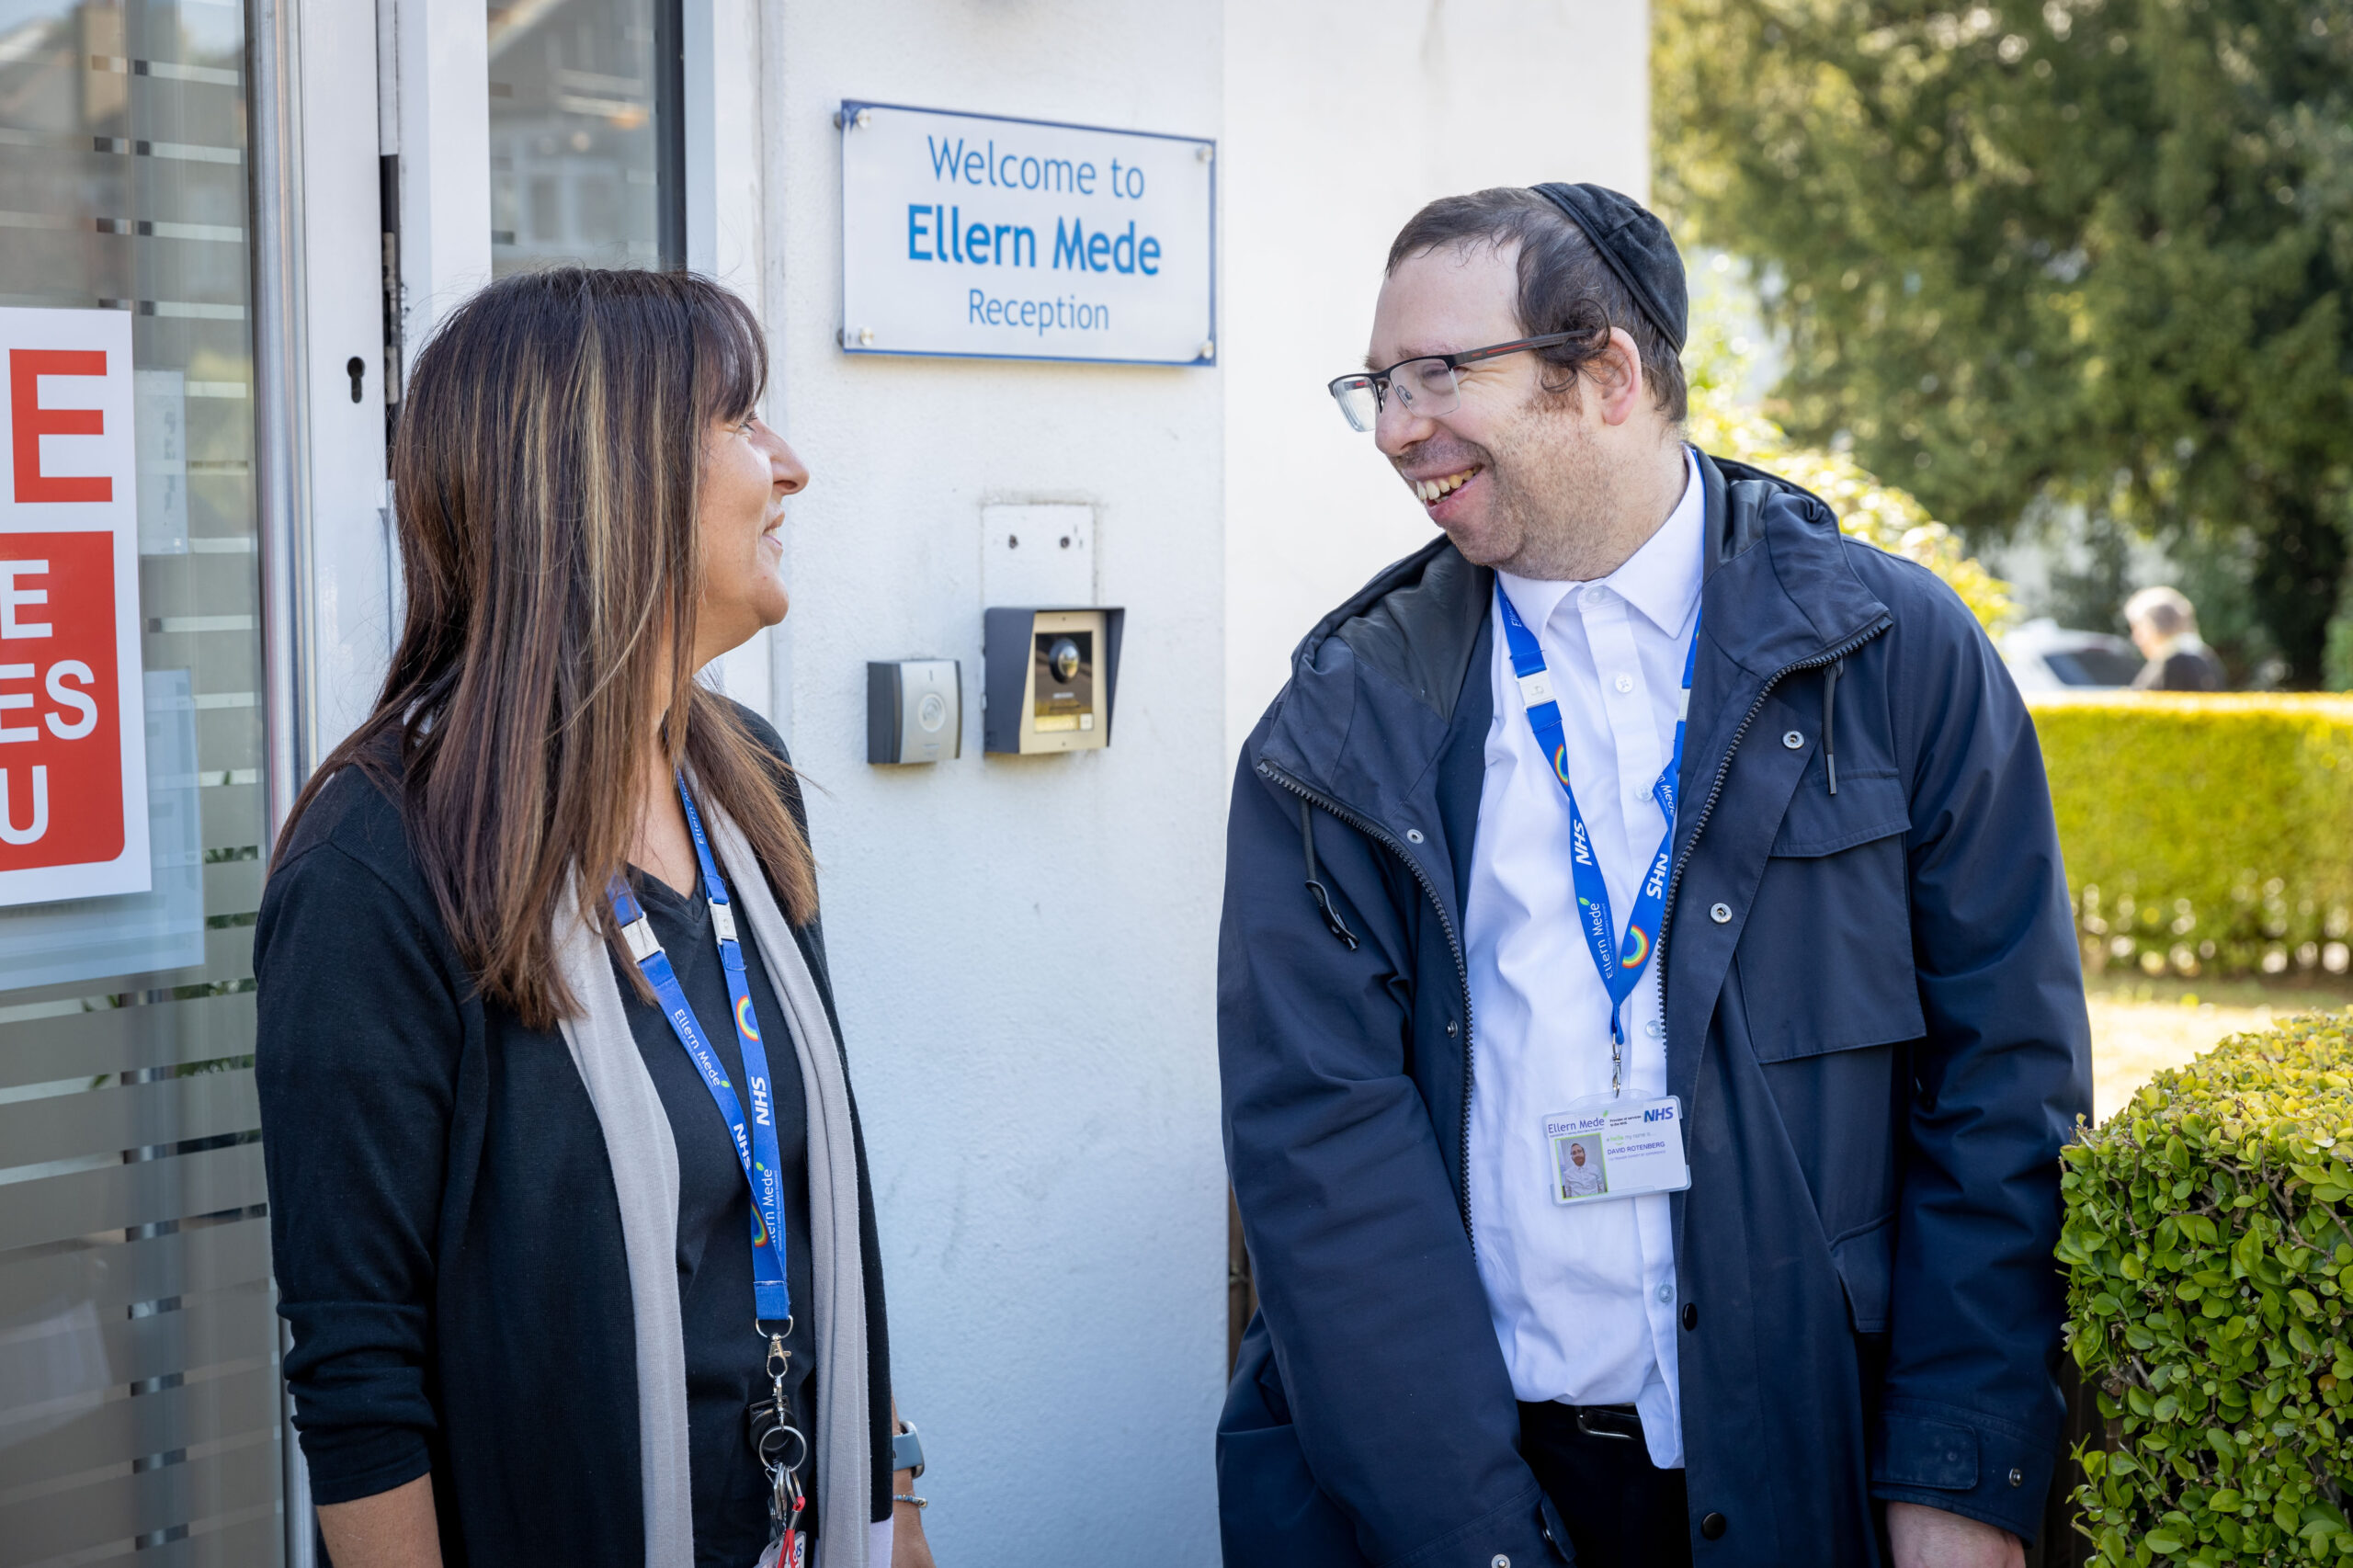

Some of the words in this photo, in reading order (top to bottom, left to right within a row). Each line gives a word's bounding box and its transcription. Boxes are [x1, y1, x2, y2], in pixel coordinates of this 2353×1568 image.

[927, 135, 1096, 195] Welcome
[1110, 158, 1144, 199] to
[908, 204, 1036, 268] Ellern
[1052, 216, 1161, 276] Mede
[969, 290, 1109, 337] Reception
[1574, 819, 1593, 866] NHS
[1646, 853, 1669, 900] NHS
[1588, 903, 1605, 937] Mede
[1597, 938, 1614, 980] Ellern
[674, 1008, 699, 1050] Ellern
[697, 1051, 721, 1086] Mede
[751, 1076, 770, 1126] NHS
[1643, 1107, 1674, 1123] NHS
[733, 1123, 751, 1170] NHS
[1548, 1122, 1576, 1134] Ellern
[1579, 1117, 1605, 1129] Mede
[1607, 1146, 1625, 1155] DAVID
[1627, 1141, 1665, 1152] ROTENBERG
[761, 1168, 775, 1207] Mede
